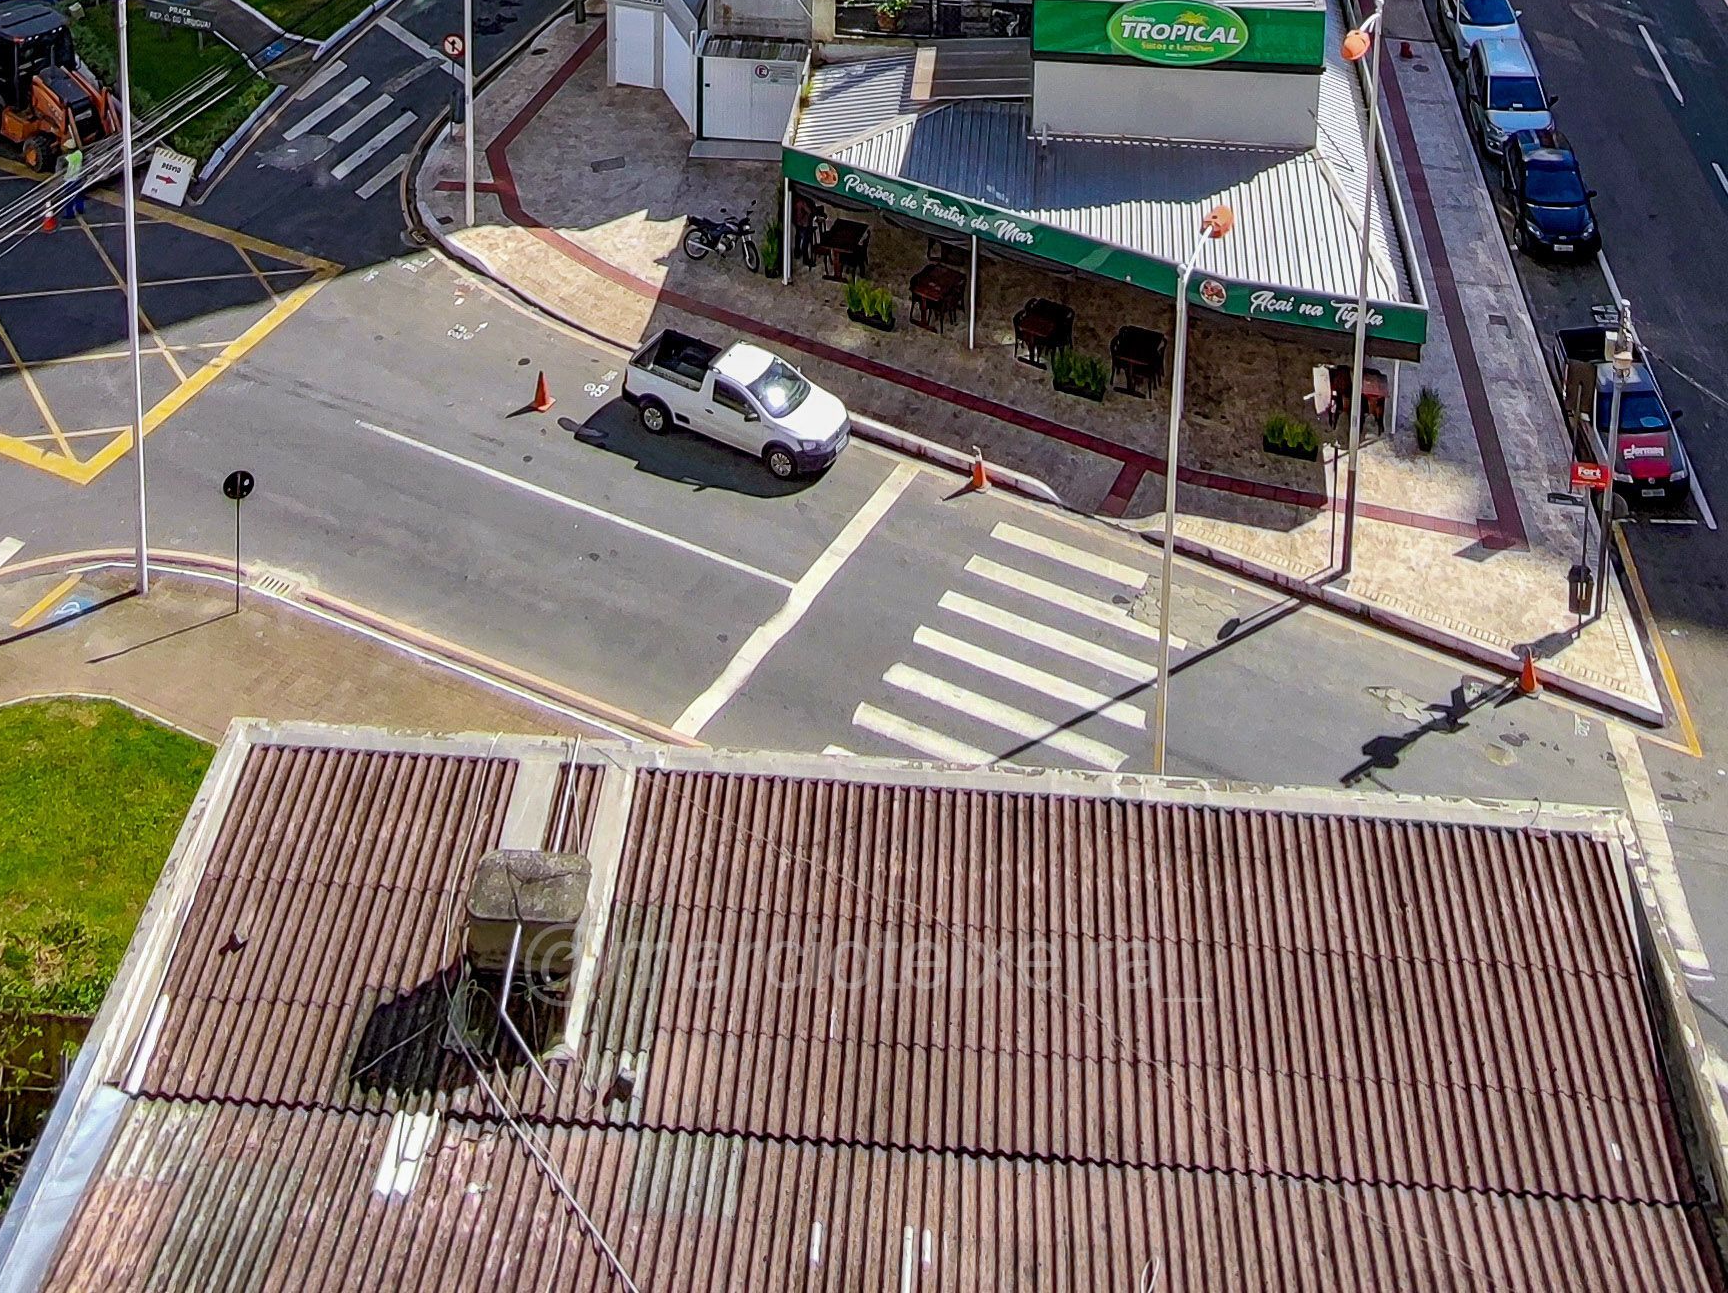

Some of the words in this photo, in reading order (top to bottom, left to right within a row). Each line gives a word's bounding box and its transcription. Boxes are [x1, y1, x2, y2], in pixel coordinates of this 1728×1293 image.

[1121, 22, 1241, 44] TROPICAL
[160, 161, 183, 174] DESVIO
[843, 173, 896, 206] Porções
[899, 192, 919, 211] de
[921, 193, 967, 228] Frutos
[970, 214, 990, 232] do
[993, 219, 1035, 246] Mar
[1298, 303, 1325, 317] na
[1330, 299, 1385, 330] Tigla
